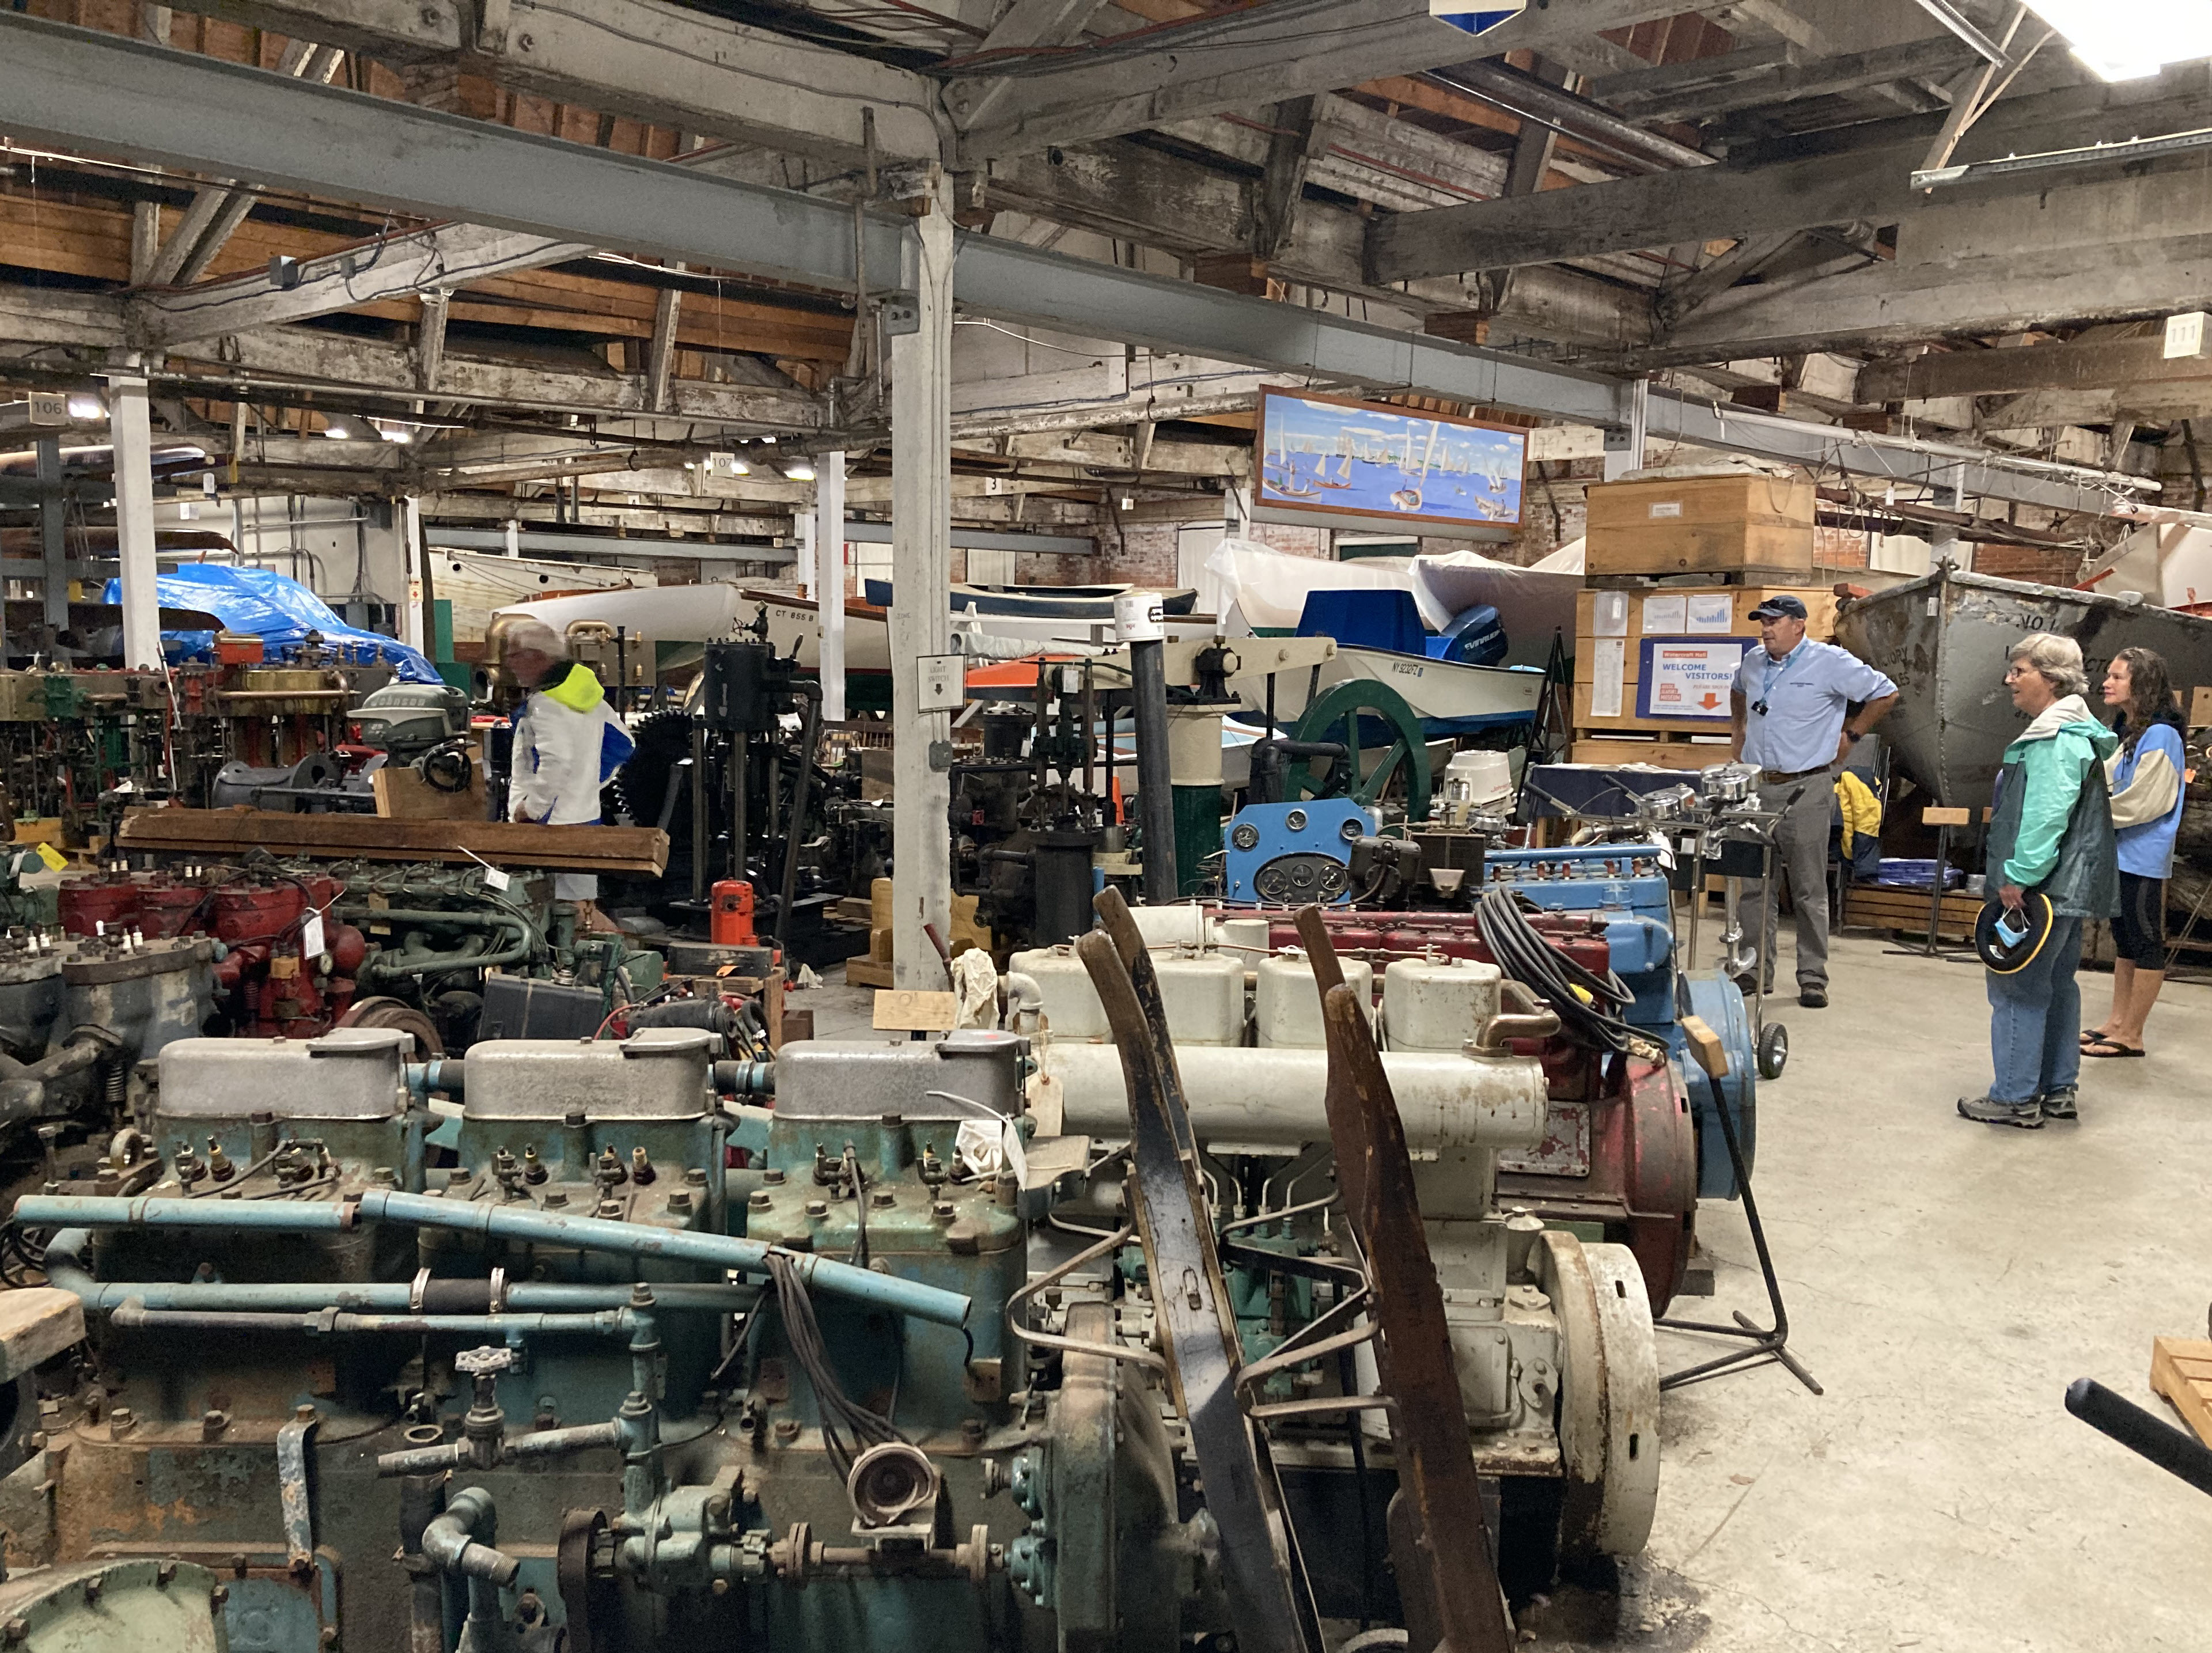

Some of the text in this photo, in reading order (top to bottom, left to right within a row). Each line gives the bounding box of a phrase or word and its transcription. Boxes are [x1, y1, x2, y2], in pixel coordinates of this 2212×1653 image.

[2170, 324, 2195, 343] 111
[35, 401, 62, 414] 106
[712, 458, 733, 467] 107
[991, 476, 997, 490] 3
[790, 612, 806, 620] 855
[1685, 672, 1732, 680] VISITORS!
[370, 695, 426, 707] Johnson
